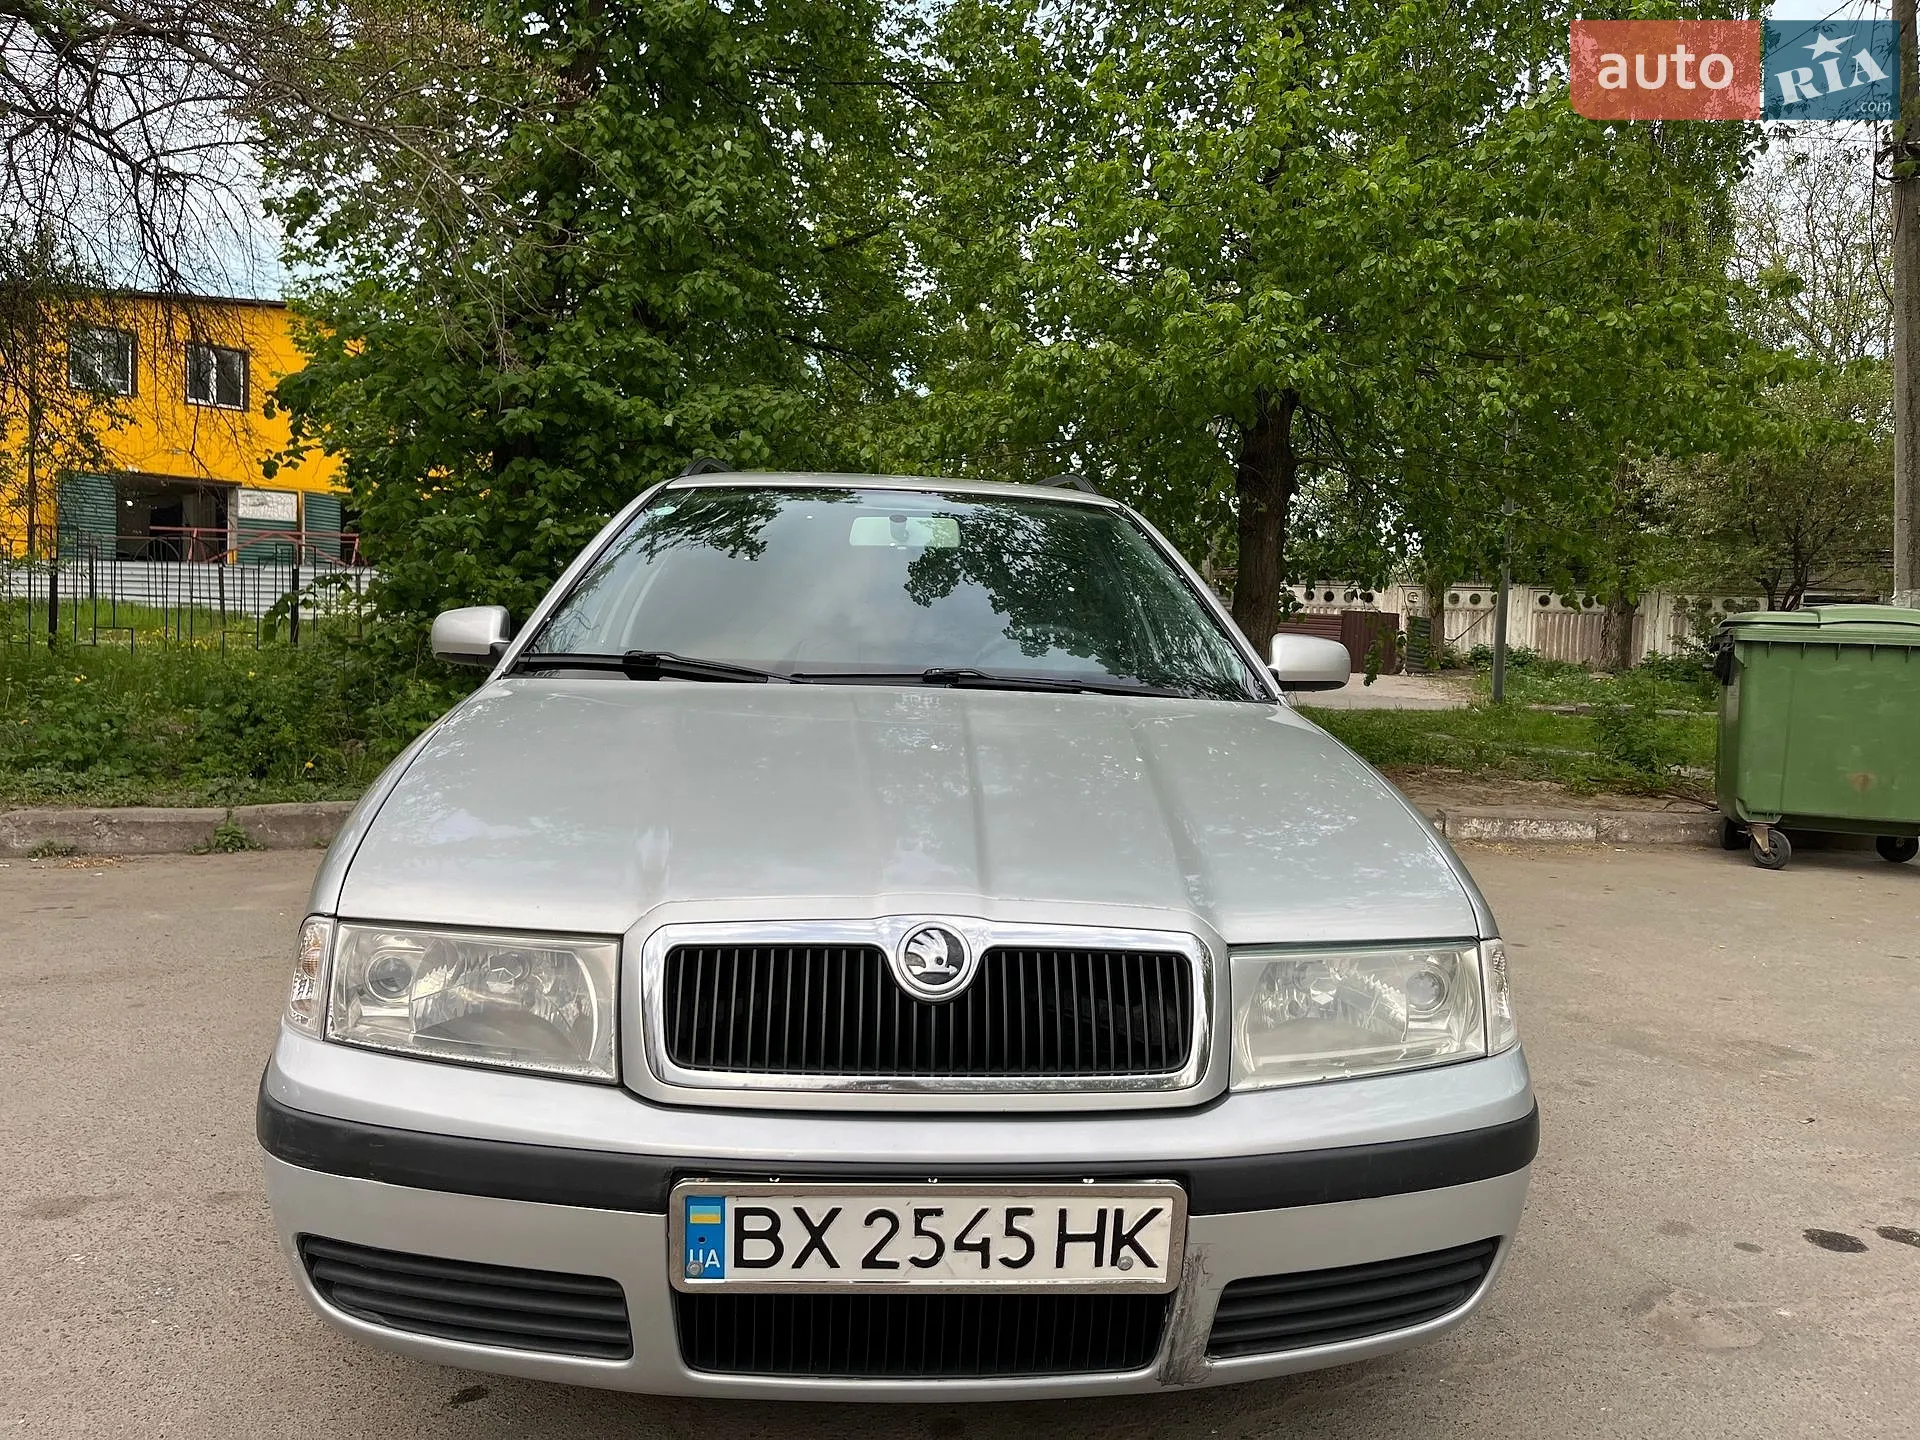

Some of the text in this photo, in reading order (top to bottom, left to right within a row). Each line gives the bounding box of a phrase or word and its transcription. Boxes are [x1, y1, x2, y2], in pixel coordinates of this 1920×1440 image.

[689, 1248, 721, 1269] UA
[733, 1206, 1163, 1270] BX 2545 HK
